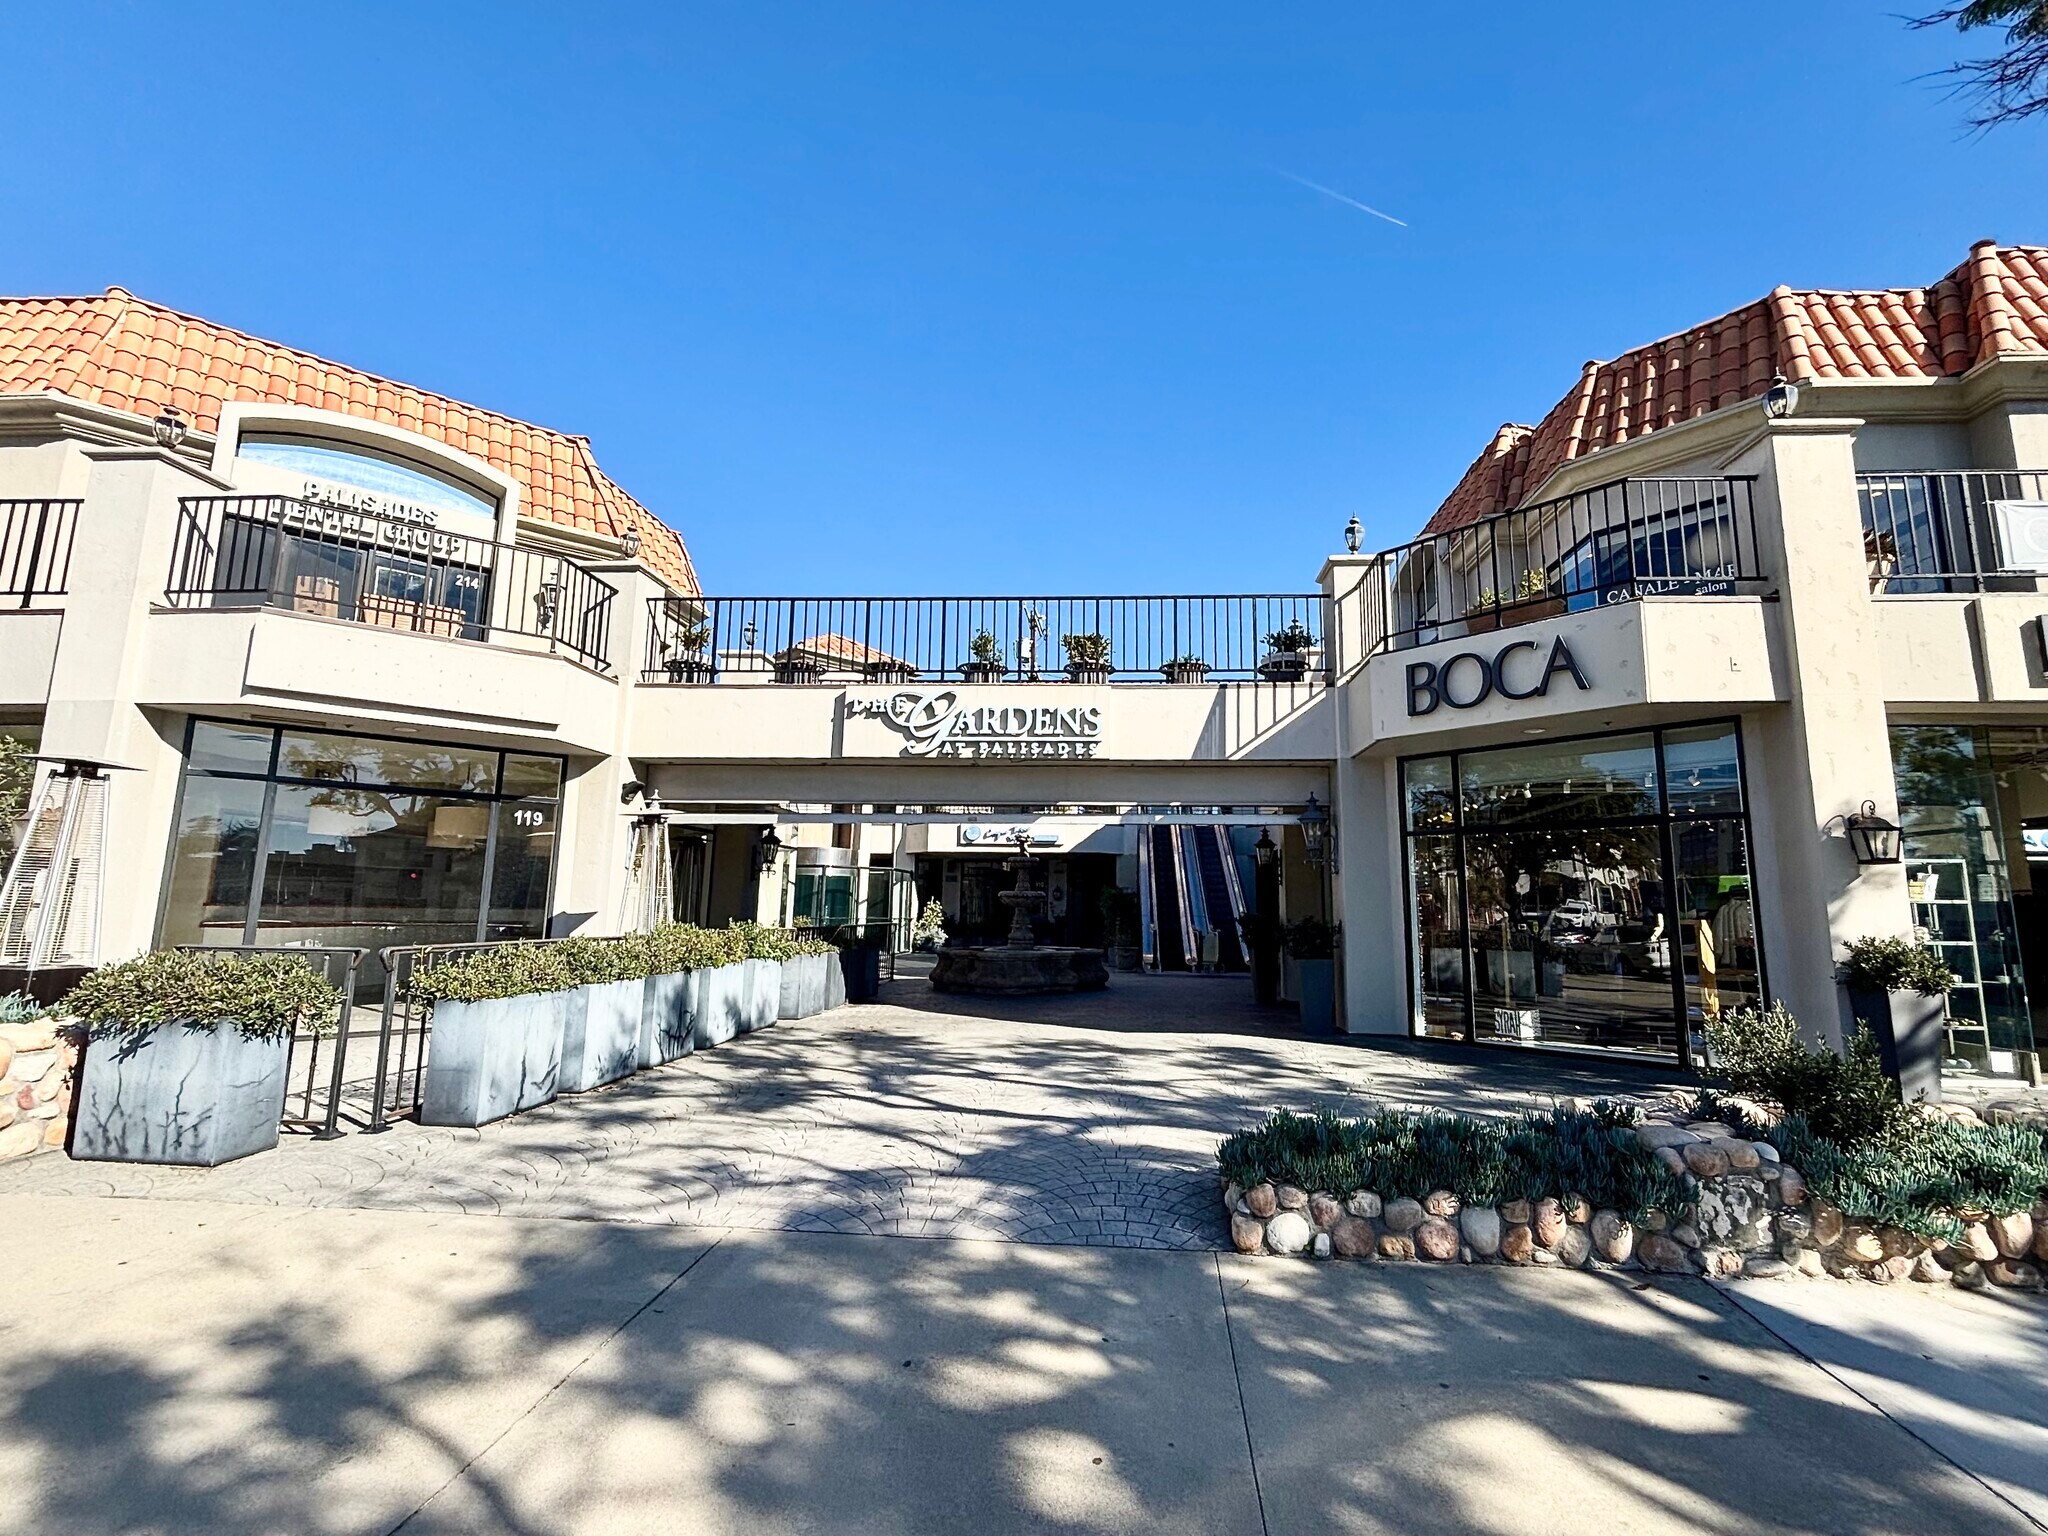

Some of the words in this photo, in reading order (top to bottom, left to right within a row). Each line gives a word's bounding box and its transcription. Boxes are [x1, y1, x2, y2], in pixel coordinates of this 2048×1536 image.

[303, 480, 439, 527] PALISADES
[384, 522, 464, 554] GROUP
[455, 574, 479, 589] 214
[1695, 582, 1727, 595] salon
[1406, 634, 1590, 716] BOCA
[848, 698, 908, 712] THE
[886, 691, 1103, 755] GARDENS
[941, 742, 966, 754] AT
[979, 742, 1100, 754] PALISADES
[514, 810, 543, 826] 119
